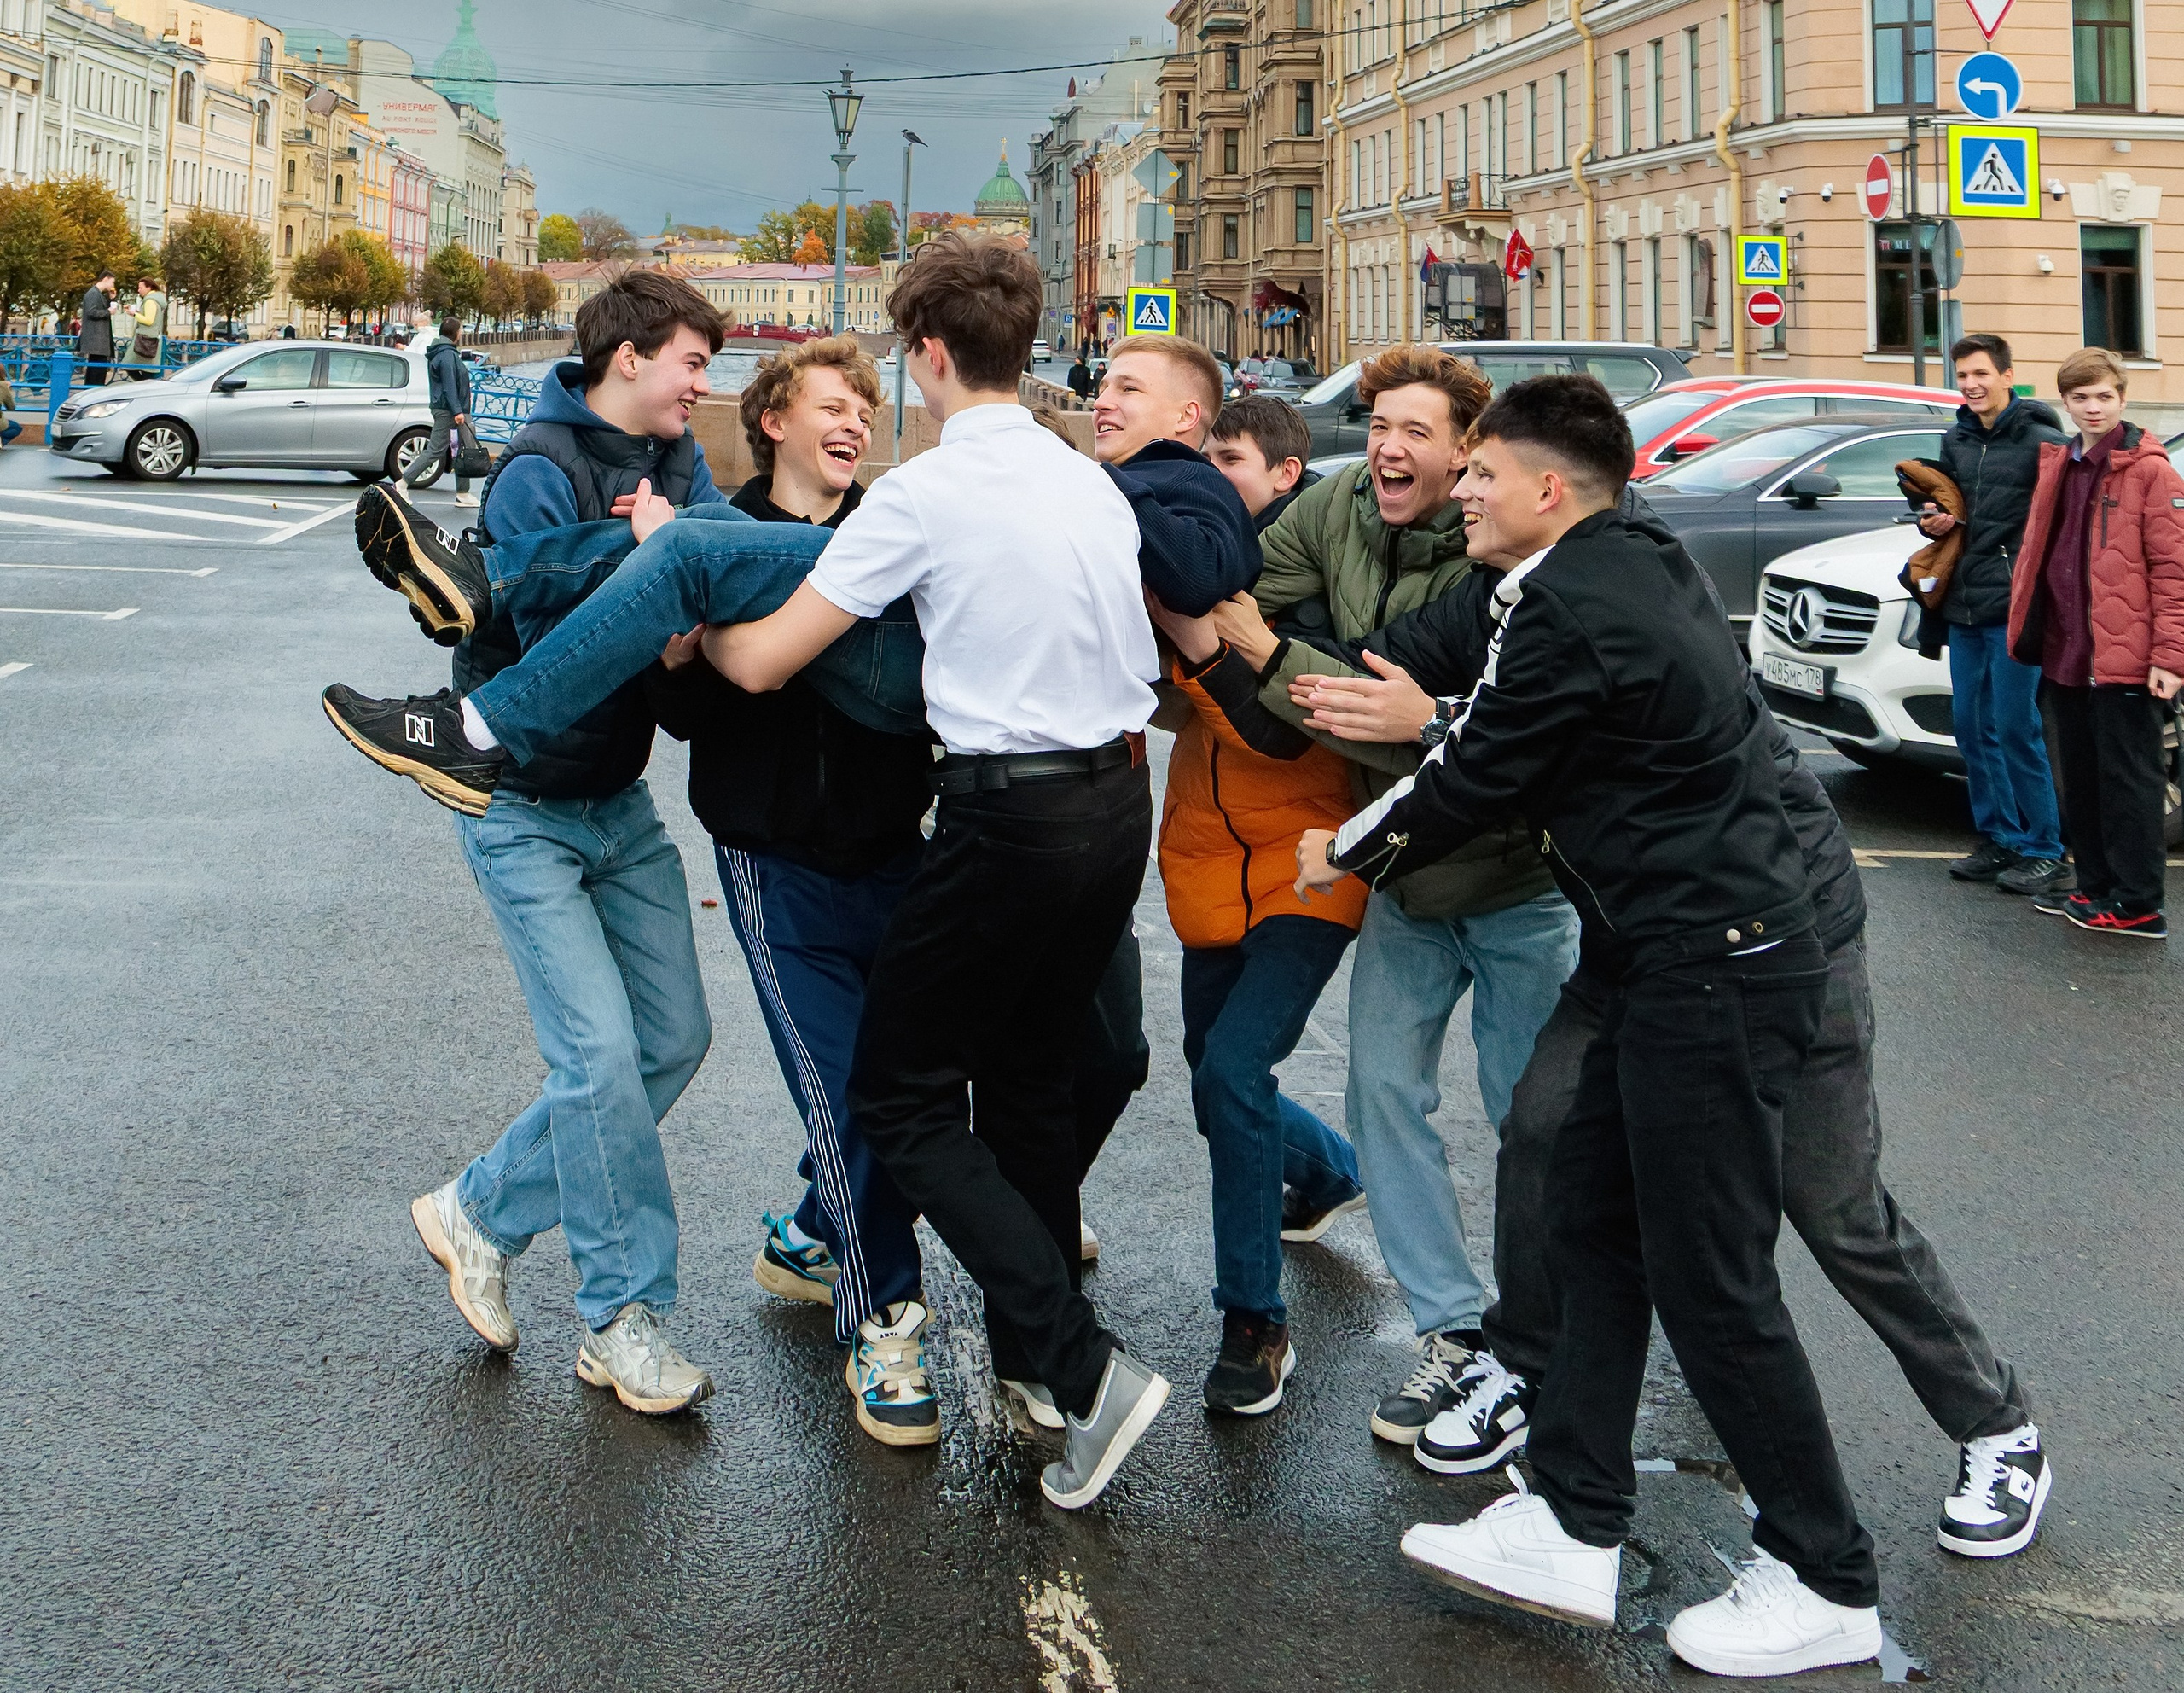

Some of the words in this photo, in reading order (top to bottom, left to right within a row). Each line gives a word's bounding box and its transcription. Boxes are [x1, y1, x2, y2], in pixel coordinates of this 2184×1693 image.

[383, 102, 438, 112] УНИВЕРМАГ
[436, 526, 460, 555] N
[1805, 667, 1821, 685] 178
[405, 713, 434, 747] N
